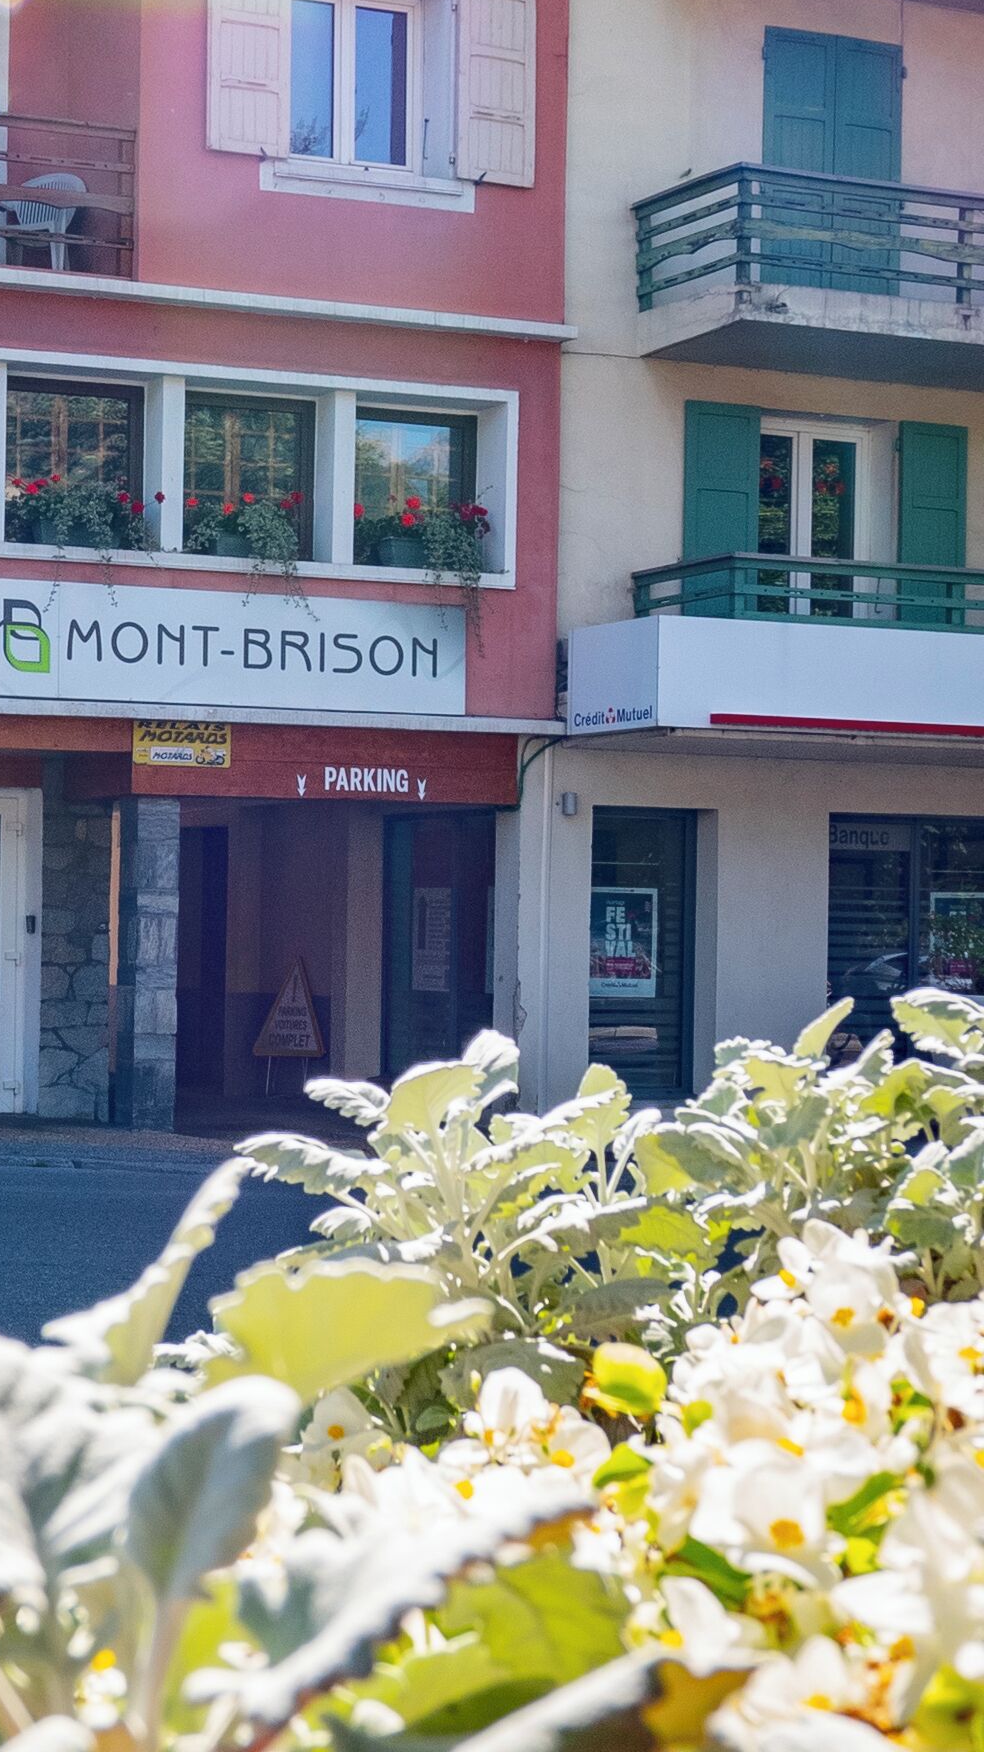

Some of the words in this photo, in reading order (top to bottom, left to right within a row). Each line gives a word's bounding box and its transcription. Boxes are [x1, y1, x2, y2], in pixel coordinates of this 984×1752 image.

[66, 618, 438, 678] MONT-BRISON
[573, 711, 605, 727] Crédit
[616, 705, 653, 723] Mutuel
[138, 730, 227, 745] MOTARDS
[324, 766, 409, 793] PARKING
[605, 906, 626, 923] FE
[605, 923, 632, 940] STI
[269, 1033, 311, 1047] COMPLET
